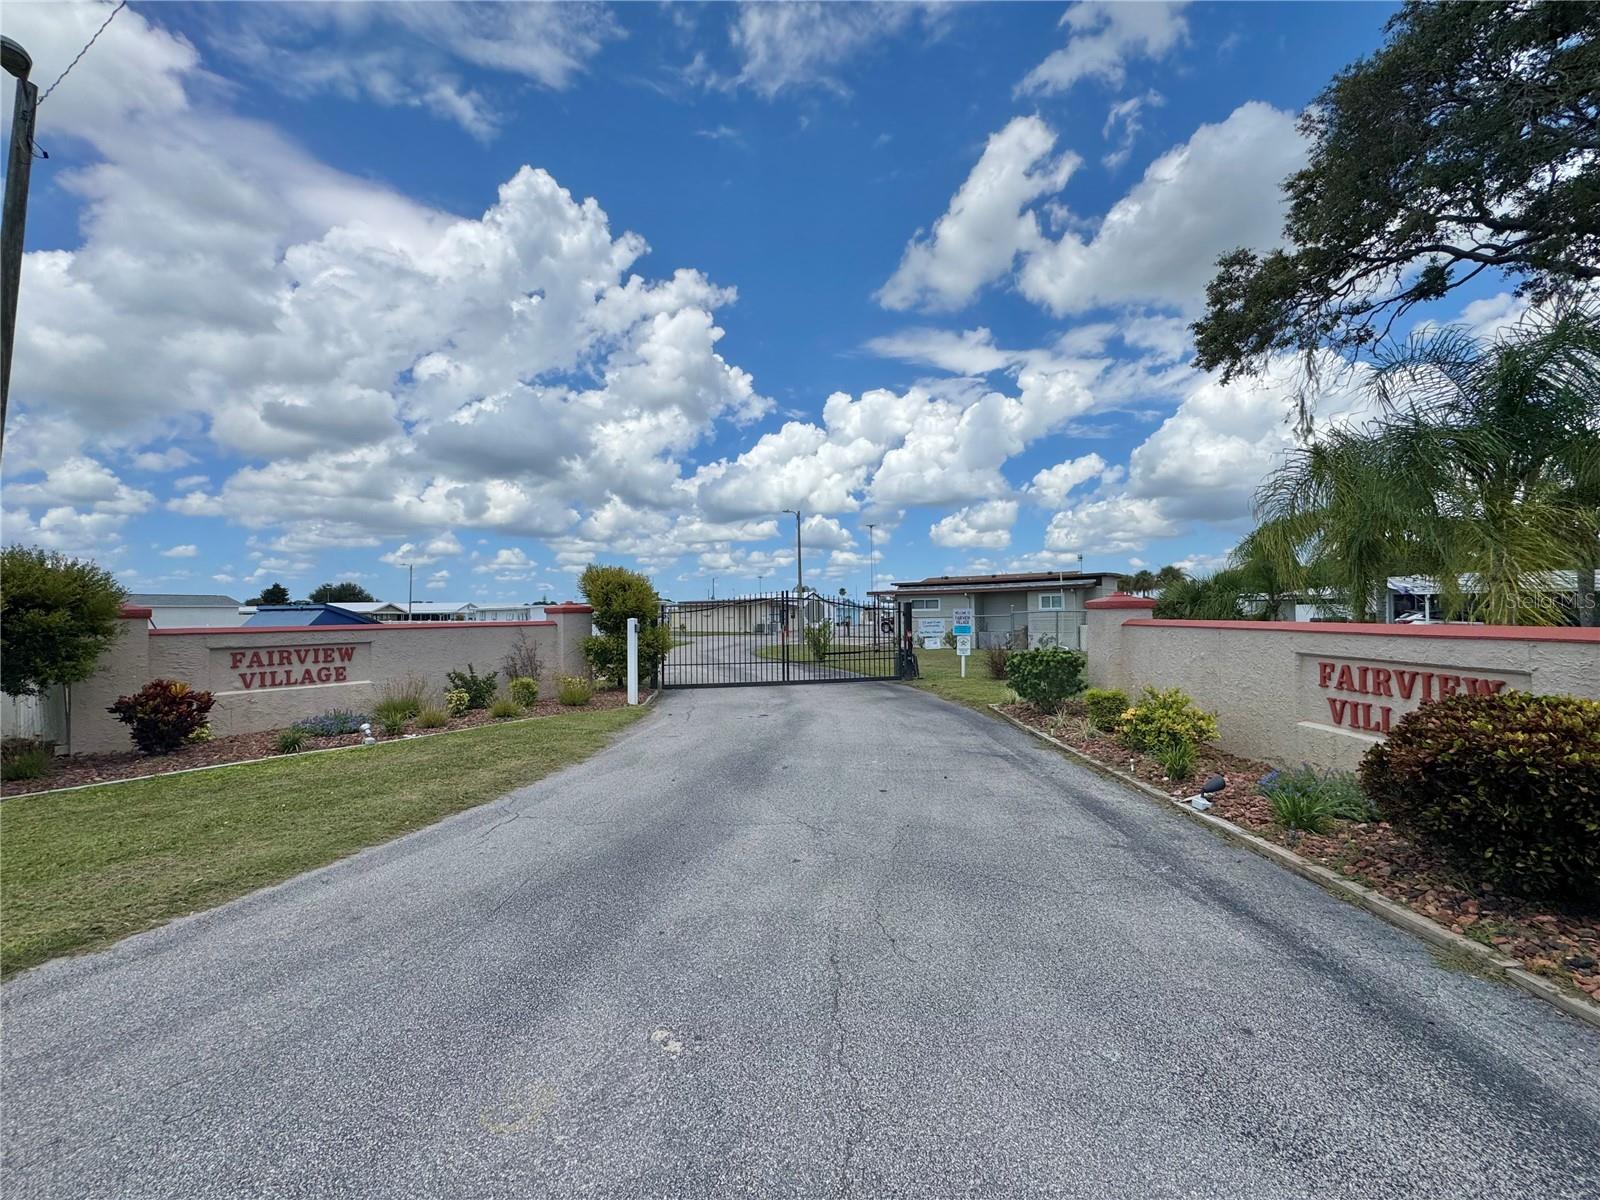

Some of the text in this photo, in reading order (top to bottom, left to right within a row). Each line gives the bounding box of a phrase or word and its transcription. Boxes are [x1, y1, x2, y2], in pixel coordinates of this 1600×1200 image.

[230, 647, 356, 669] FAIRVIEW
[239, 666, 347, 688] VILLAGE
[1318, 662, 1506, 703] FAIRVIEW
